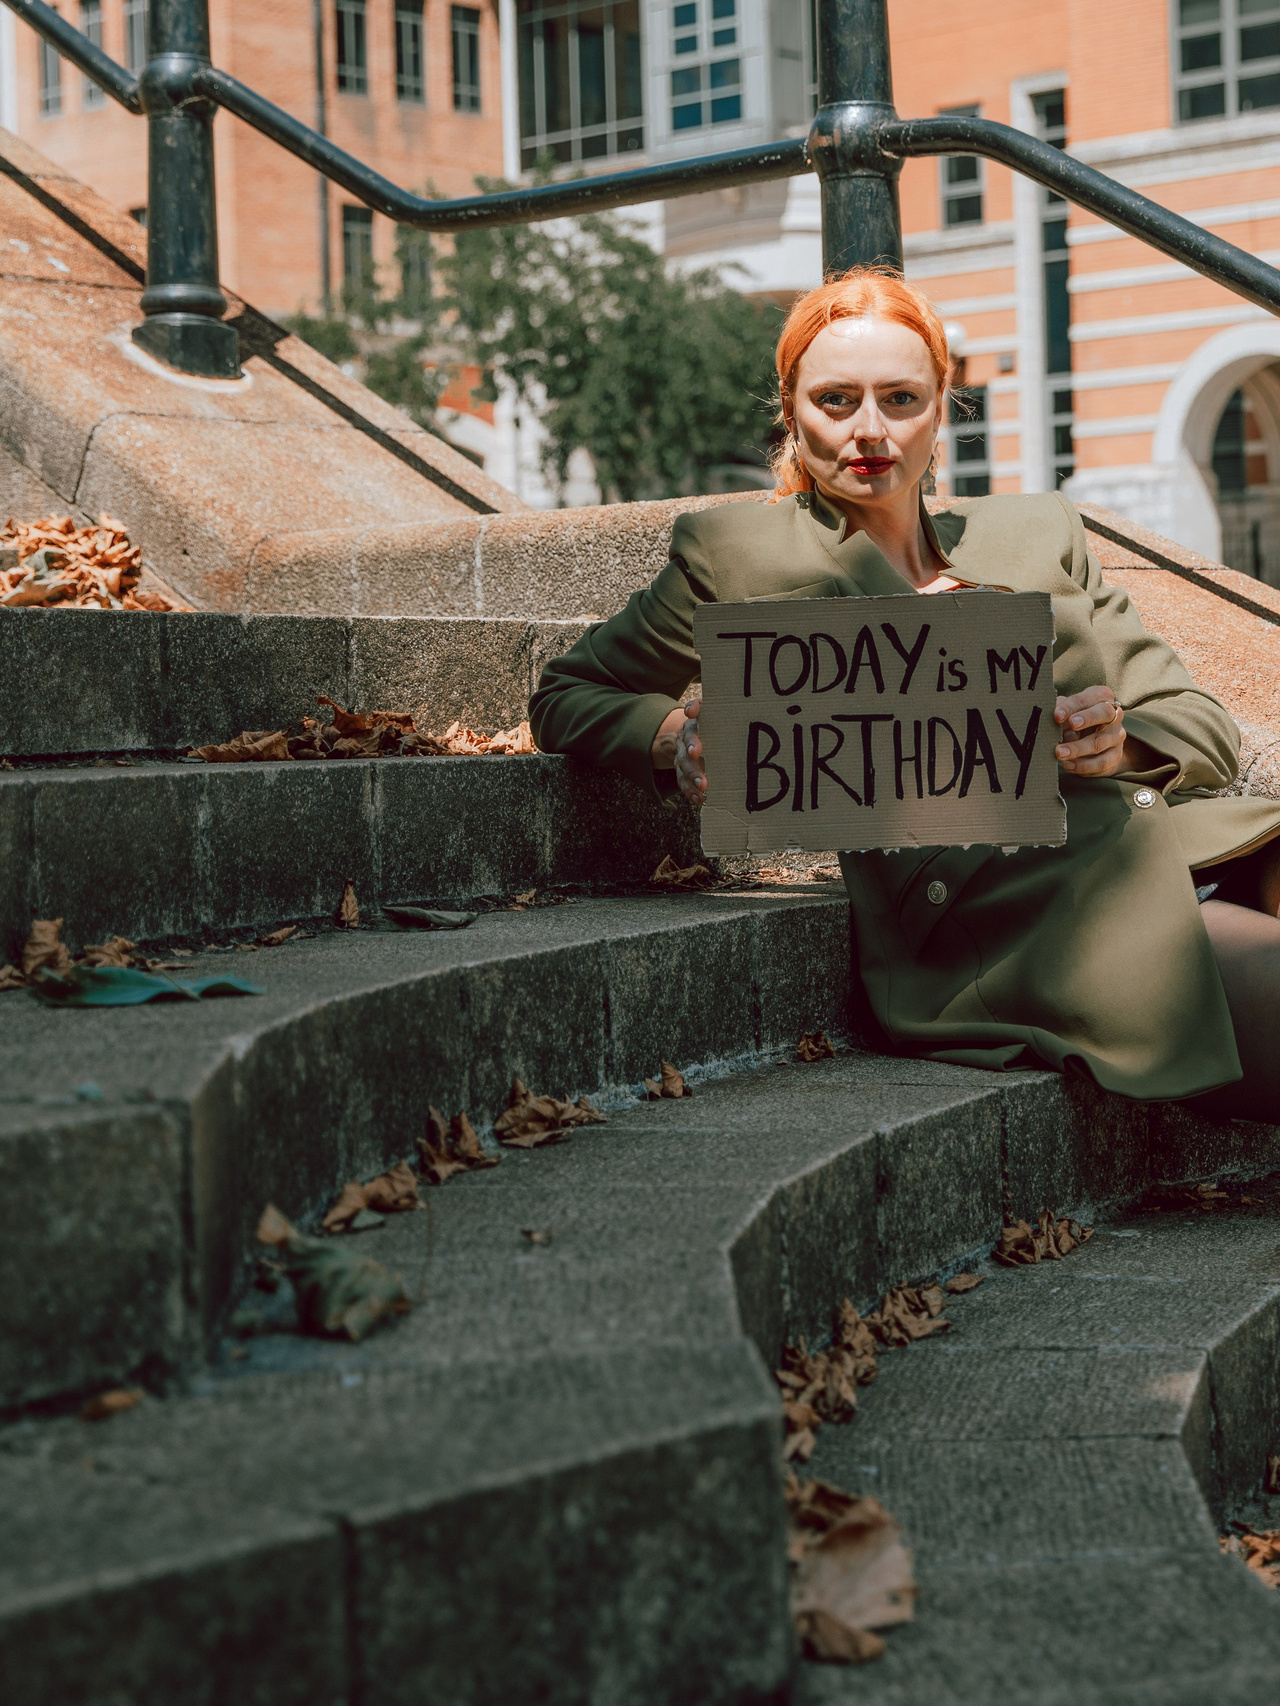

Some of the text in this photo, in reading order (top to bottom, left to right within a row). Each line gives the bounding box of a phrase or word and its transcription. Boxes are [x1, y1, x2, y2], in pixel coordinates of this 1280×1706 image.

[717, 622, 1048, 698] TODAY is MY
